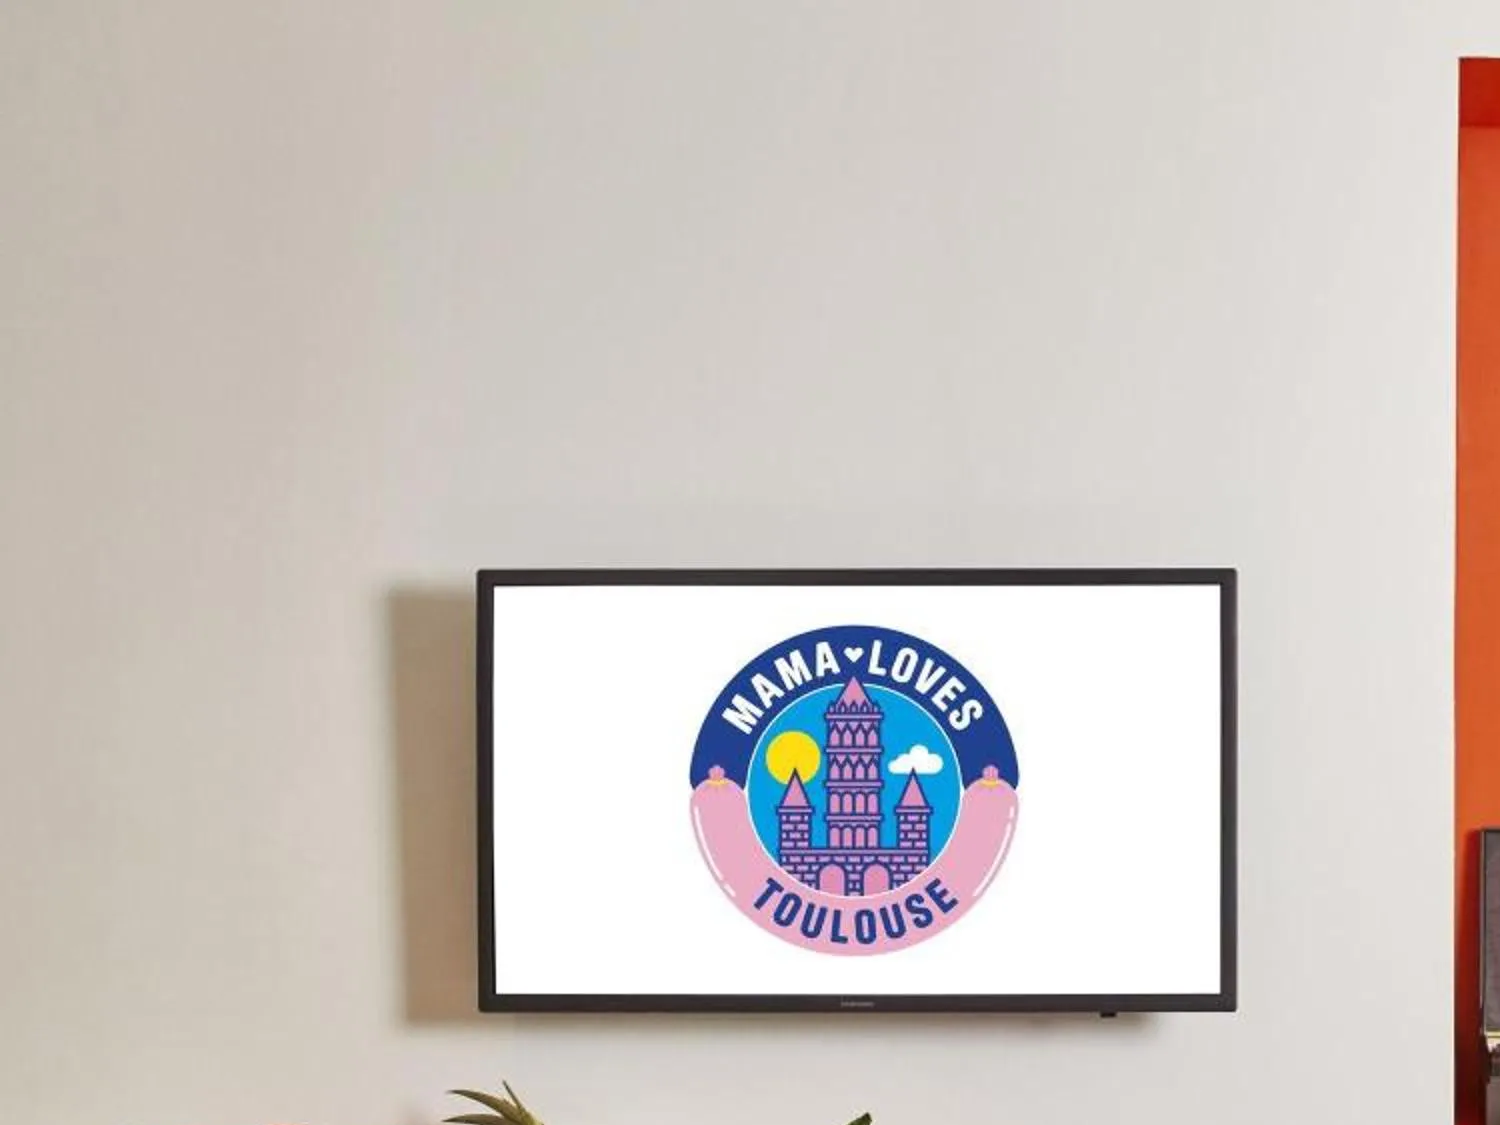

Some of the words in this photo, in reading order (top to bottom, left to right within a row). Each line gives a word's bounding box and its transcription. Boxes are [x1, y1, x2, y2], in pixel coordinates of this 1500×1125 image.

[721, 641, 841, 735] MAMA
[868, 639, 983, 731] LOVES
[753, 877, 960, 945] TOULOUSE
